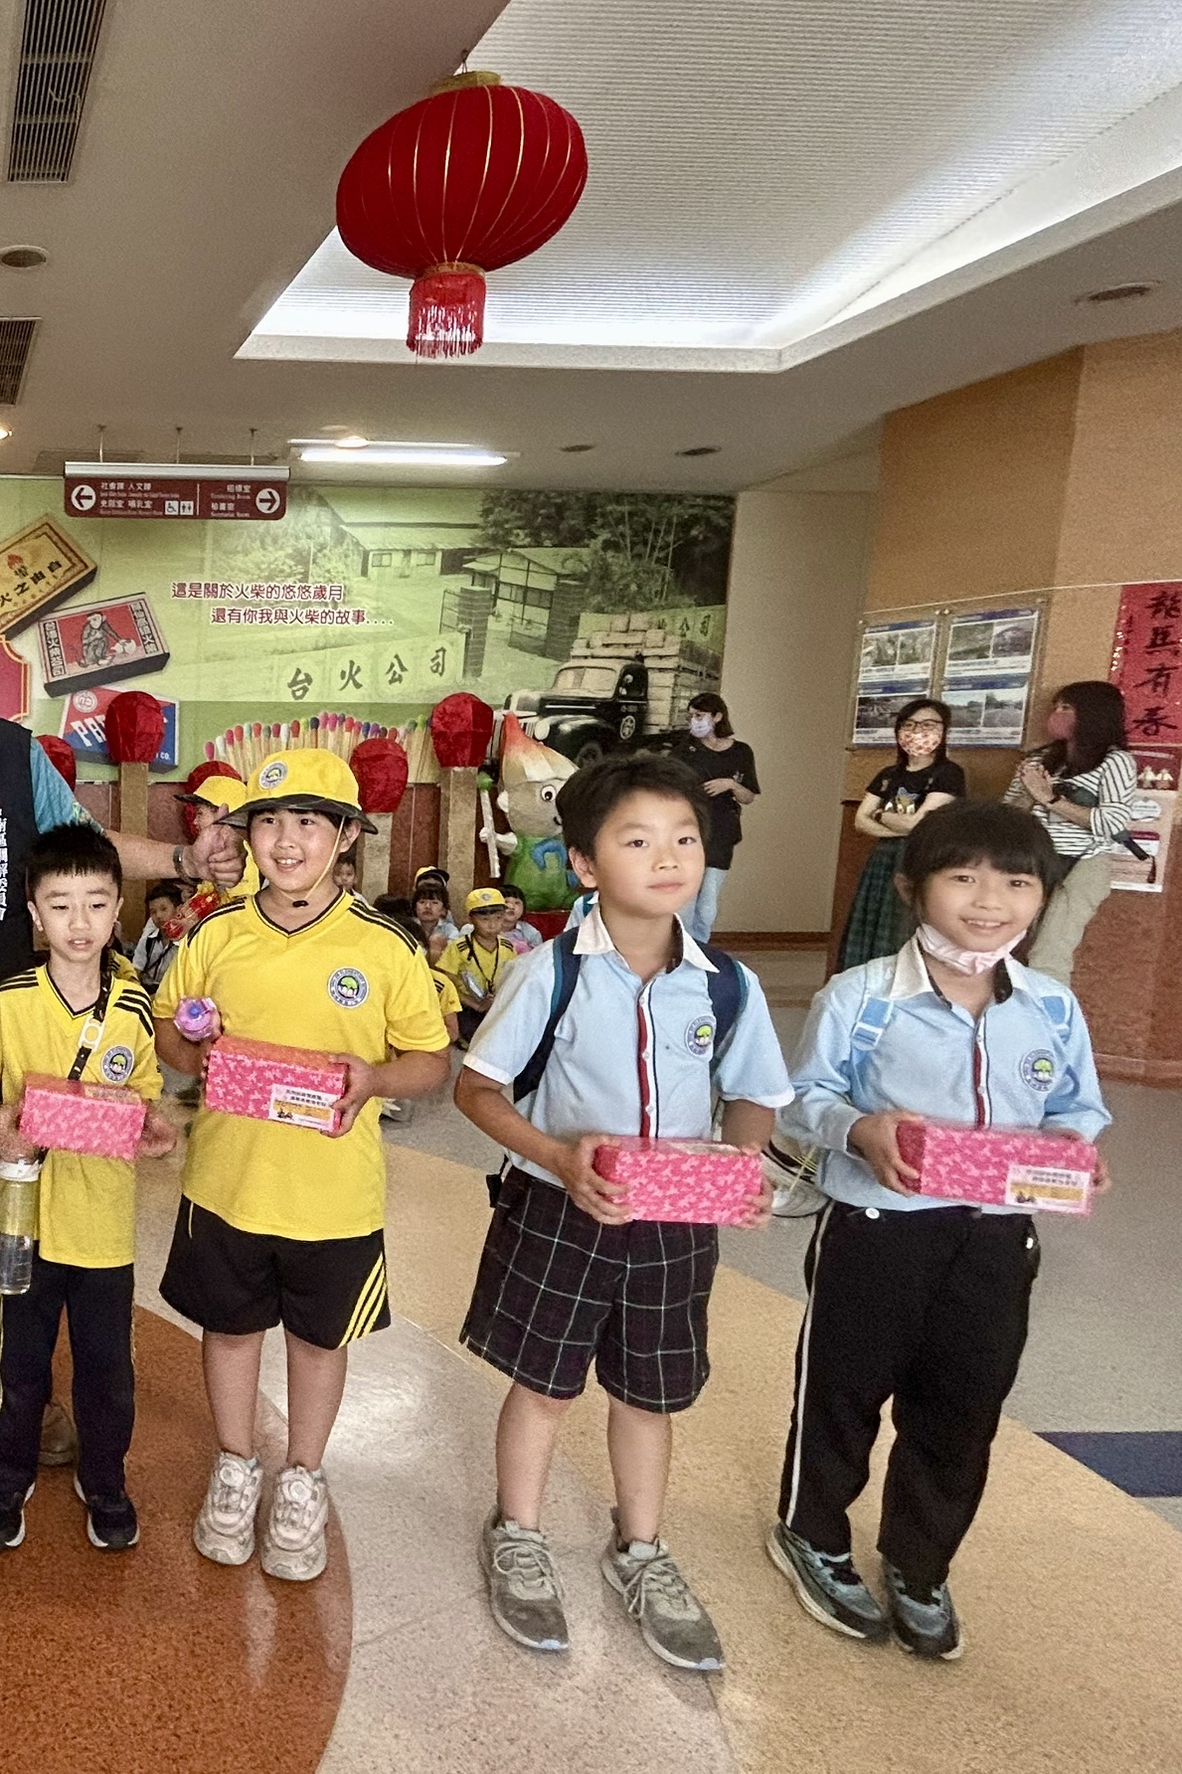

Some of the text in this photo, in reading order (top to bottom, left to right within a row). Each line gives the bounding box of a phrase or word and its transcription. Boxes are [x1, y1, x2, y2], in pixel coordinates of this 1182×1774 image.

[171, 582, 343, 600] 這是關於火柴的悠悠歲月
[287, 646, 447, 700] 台火公司
